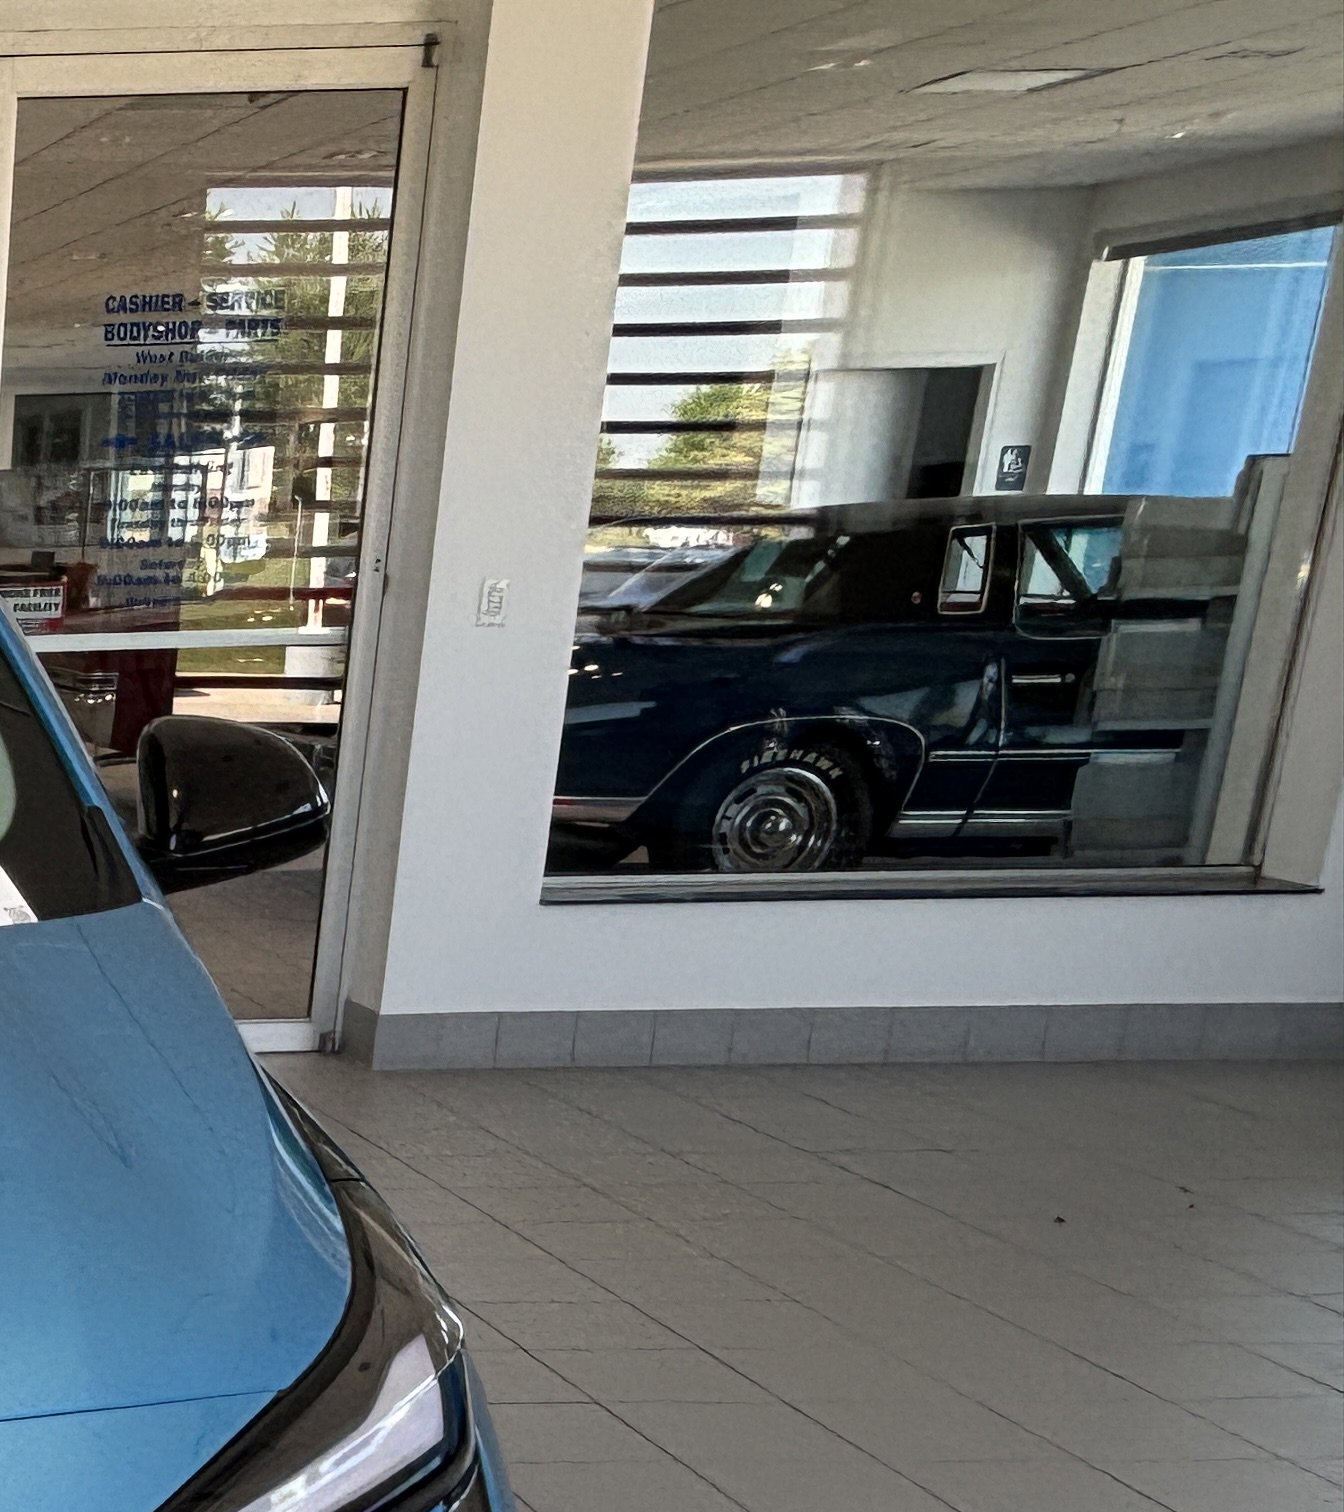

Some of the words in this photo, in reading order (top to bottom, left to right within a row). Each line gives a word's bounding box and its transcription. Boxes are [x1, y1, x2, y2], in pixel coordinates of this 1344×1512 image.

[104, 293, 185, 315] CASHIER
[206, 290, 286, 311] SERVICE
[103, 320, 202, 342] BODYSHOP
[224, 318, 282, 338] PARTS
[13, 601, 61, 613] FACILITY
